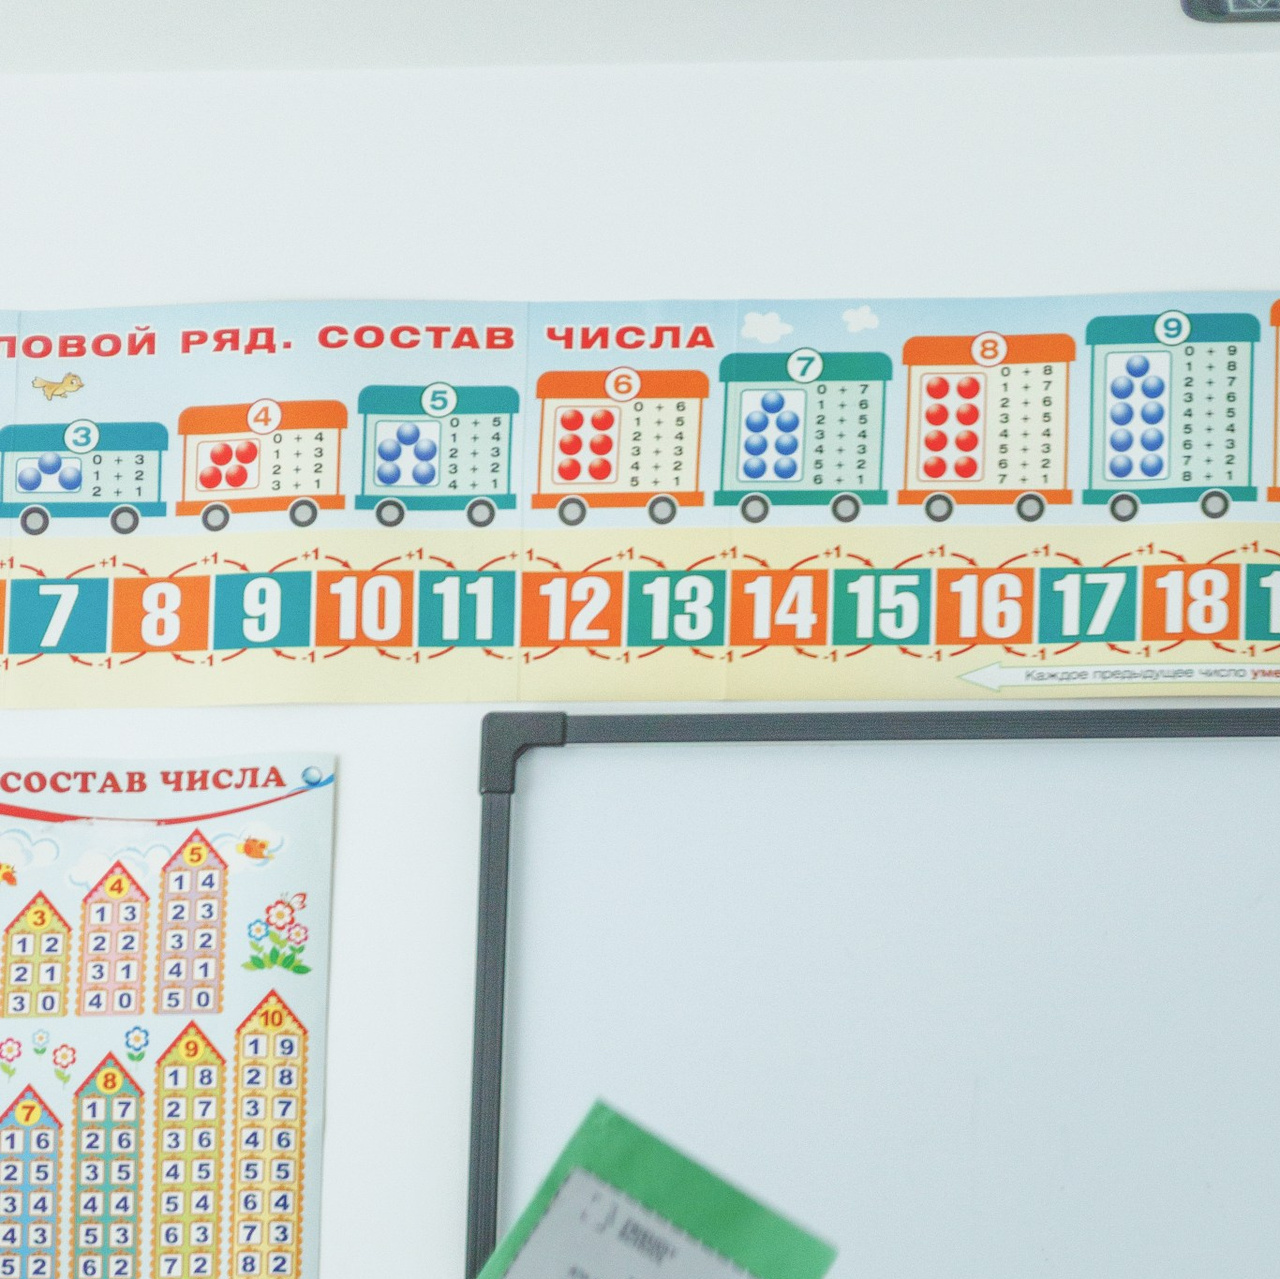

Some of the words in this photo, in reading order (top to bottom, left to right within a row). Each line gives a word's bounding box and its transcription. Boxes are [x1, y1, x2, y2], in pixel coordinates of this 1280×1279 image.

[1163, 317, 1183, 338] 9
[181, 327, 292, 354] РЯД.
[318, 325, 515, 349] СОСТАВ
[546, 325, 715, 349] ЧИСЛА
[980, 339, 999, 360] 8
[796, 356, 815, 376] 7
[613, 374, 633, 395] 6
[430, 389, 448, 411] 5
[253, 406, 272, 426] 4
[72, 426, 92, 448] 3
[39, 584, 79, 647] 7
[141, 582, 182, 646] 8
[243, 577, 281, 642] 9
[329, 575, 402, 641] 10
[432, 576, 493, 641] 11
[538, 576, 611, 641] 12
[642, 575, 714, 641] 13
[744, 574, 818, 640] 14
[847, 574, 920, 640] 15
[950, 574, 1022, 639] 16
[1053, 572, 1127, 637] 17
[1156, 571, 1230, 637] 18
[1199, 667, 1247, 679] число
[0, 771, 148, 793] СОСТАВ
[161, 766, 287, 792] ЧИСЛА
[189, 846, 203, 863] 5
[109, 878, 123, 895] 4
[33, 909, 46, 927] 3
[260, 1009, 283, 1027] 10
[185, 1040, 198, 1058] 9
[103, 1072, 117, 1090] 8
[21, 1105, 36, 1122] 7
